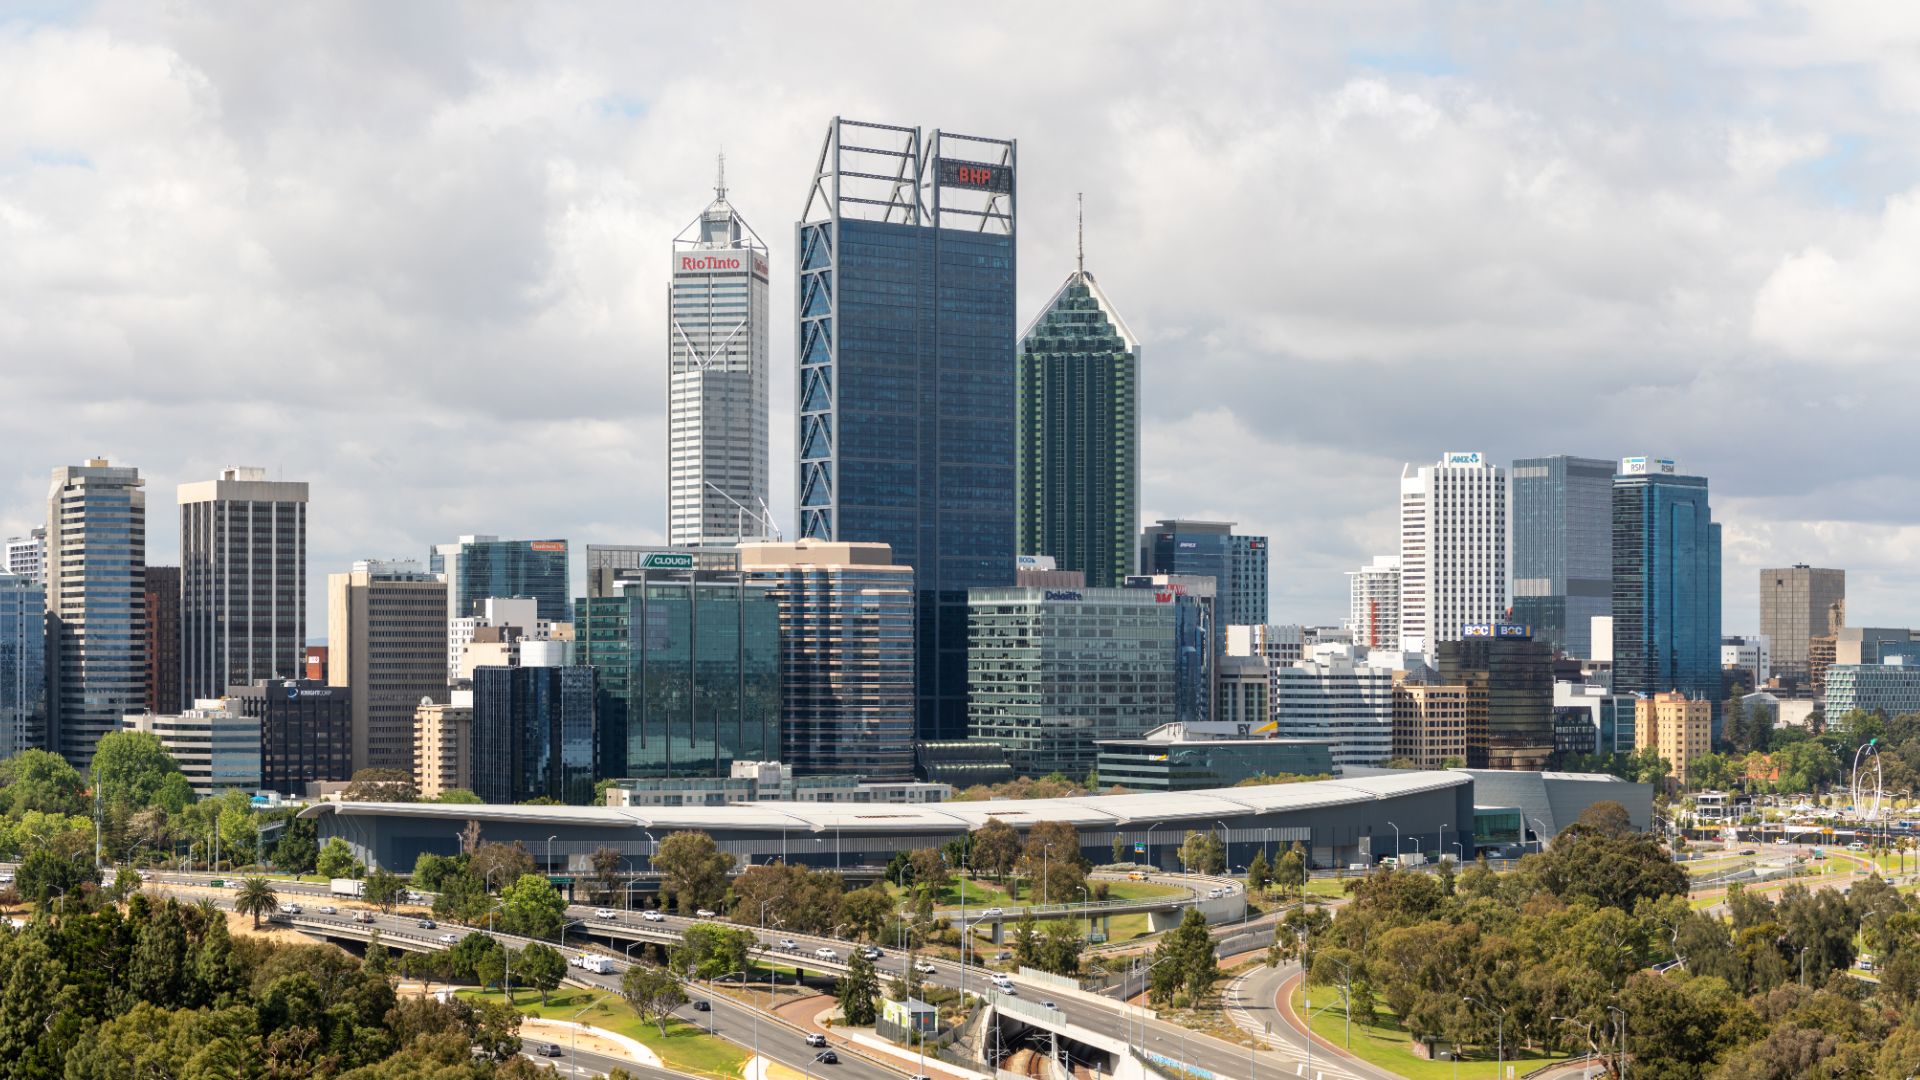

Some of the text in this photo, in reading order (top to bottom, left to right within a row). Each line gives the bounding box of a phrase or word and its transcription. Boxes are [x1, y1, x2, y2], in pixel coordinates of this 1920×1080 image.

[959, 166, 991, 184] BHP
[654, 557, 691, 565] CLOUGH
[1045, 590, 1082, 600] Deloitte
